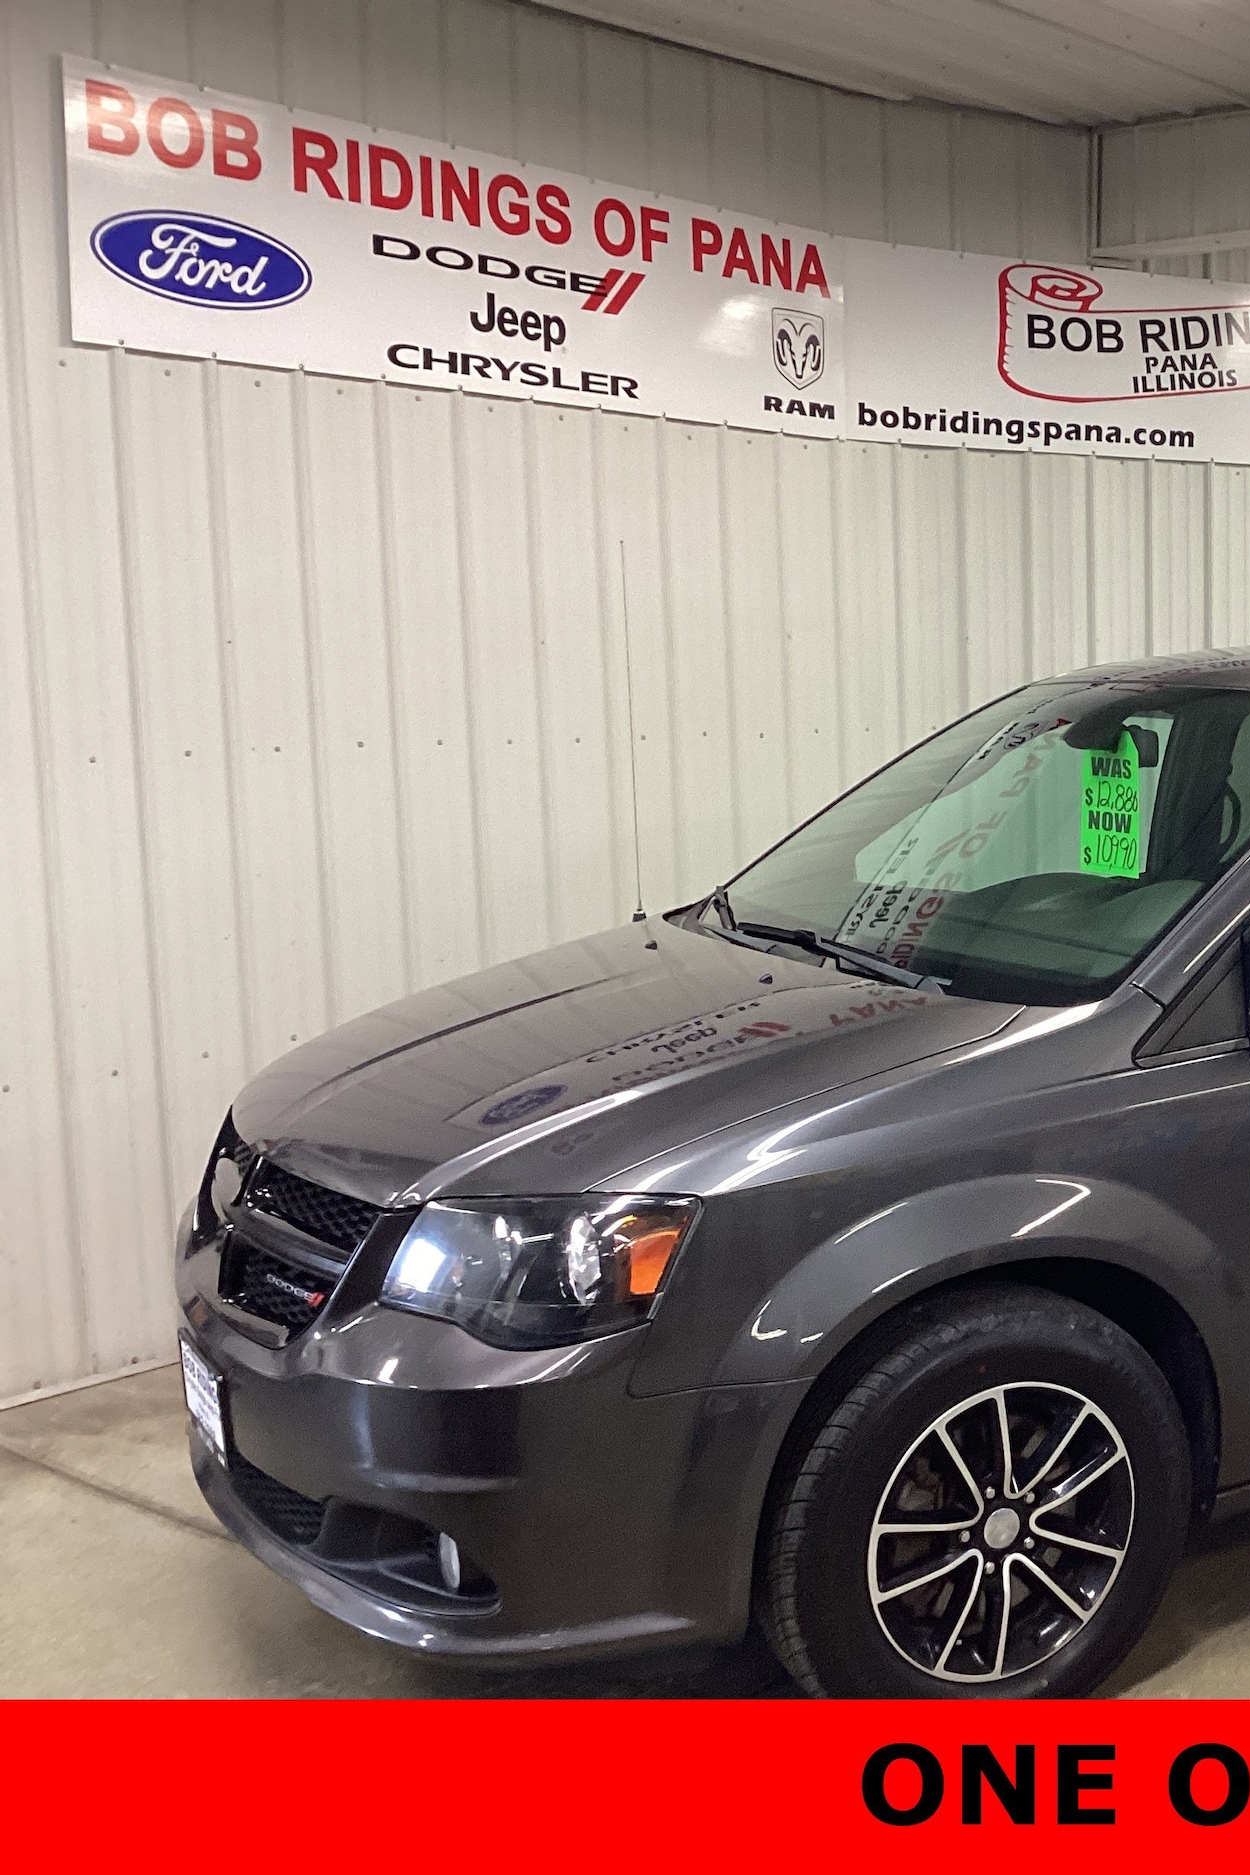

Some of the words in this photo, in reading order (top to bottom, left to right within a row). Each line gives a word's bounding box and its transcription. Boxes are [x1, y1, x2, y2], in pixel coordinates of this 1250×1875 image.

[85, 79, 262, 181] BOB
[292, 127, 572, 245] RIDINGS
[594, 198, 670, 262] OF
[691, 217, 831, 299] PANA
[138, 224, 269, 296] Ford
[372, 234, 609, 298] DODGE
[470, 292, 567, 352] Jeep
[1027, 314, 1124, 353] BOB
[387, 343, 640, 400] CHRYSLER
[1132, 369, 1238, 394] ILLINOIS
[1145, 353, 1218, 374] PANA
[763, 395, 836, 421] RAM
[858, 402, 1195, 448] bobridingspana.com
[1091, 756, 1131, 779] WAS
[1088, 810, 1132, 833] NOW
[266, 1273, 314, 1303] DODGE
